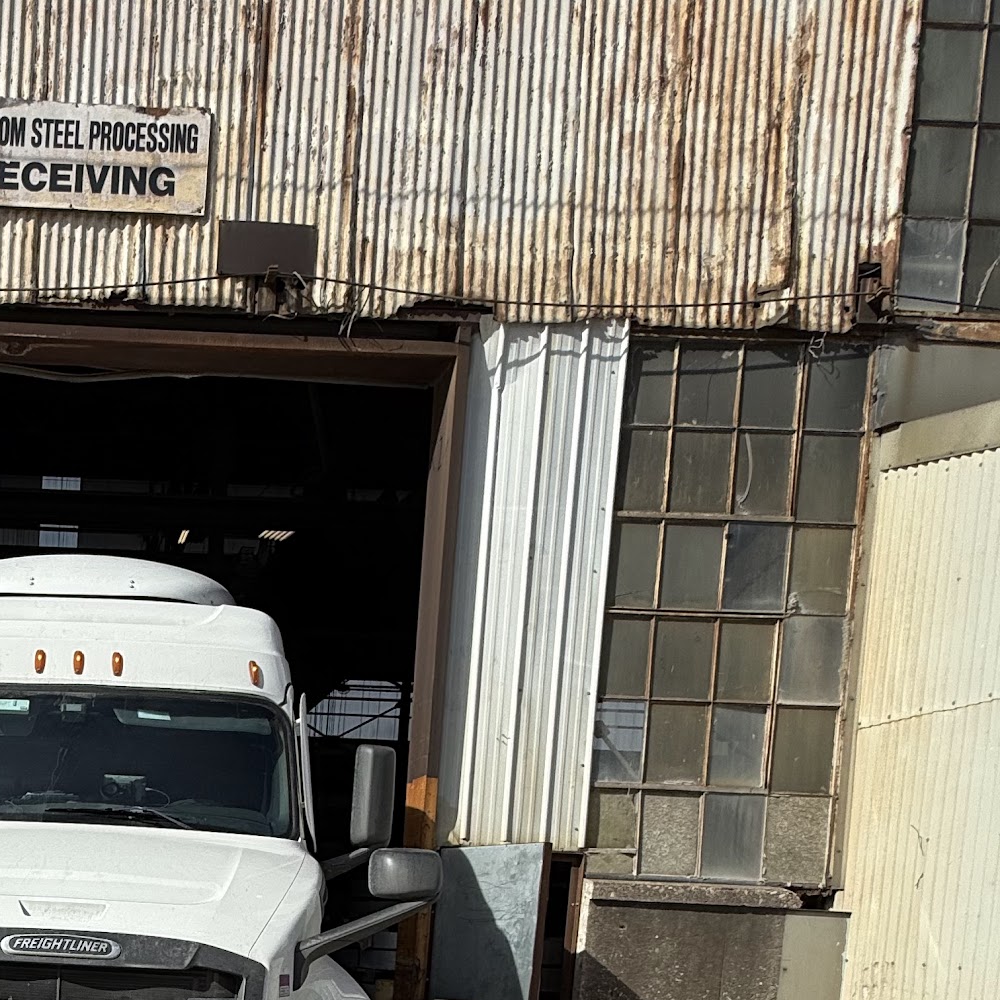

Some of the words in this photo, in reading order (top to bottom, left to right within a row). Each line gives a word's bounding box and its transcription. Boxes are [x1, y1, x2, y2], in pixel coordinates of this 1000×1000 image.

[31, 117, 84, 150] STEEL
[89, 120, 199, 154] PROCESSING
[13, 938, 108, 953] FREIGHTLINER
